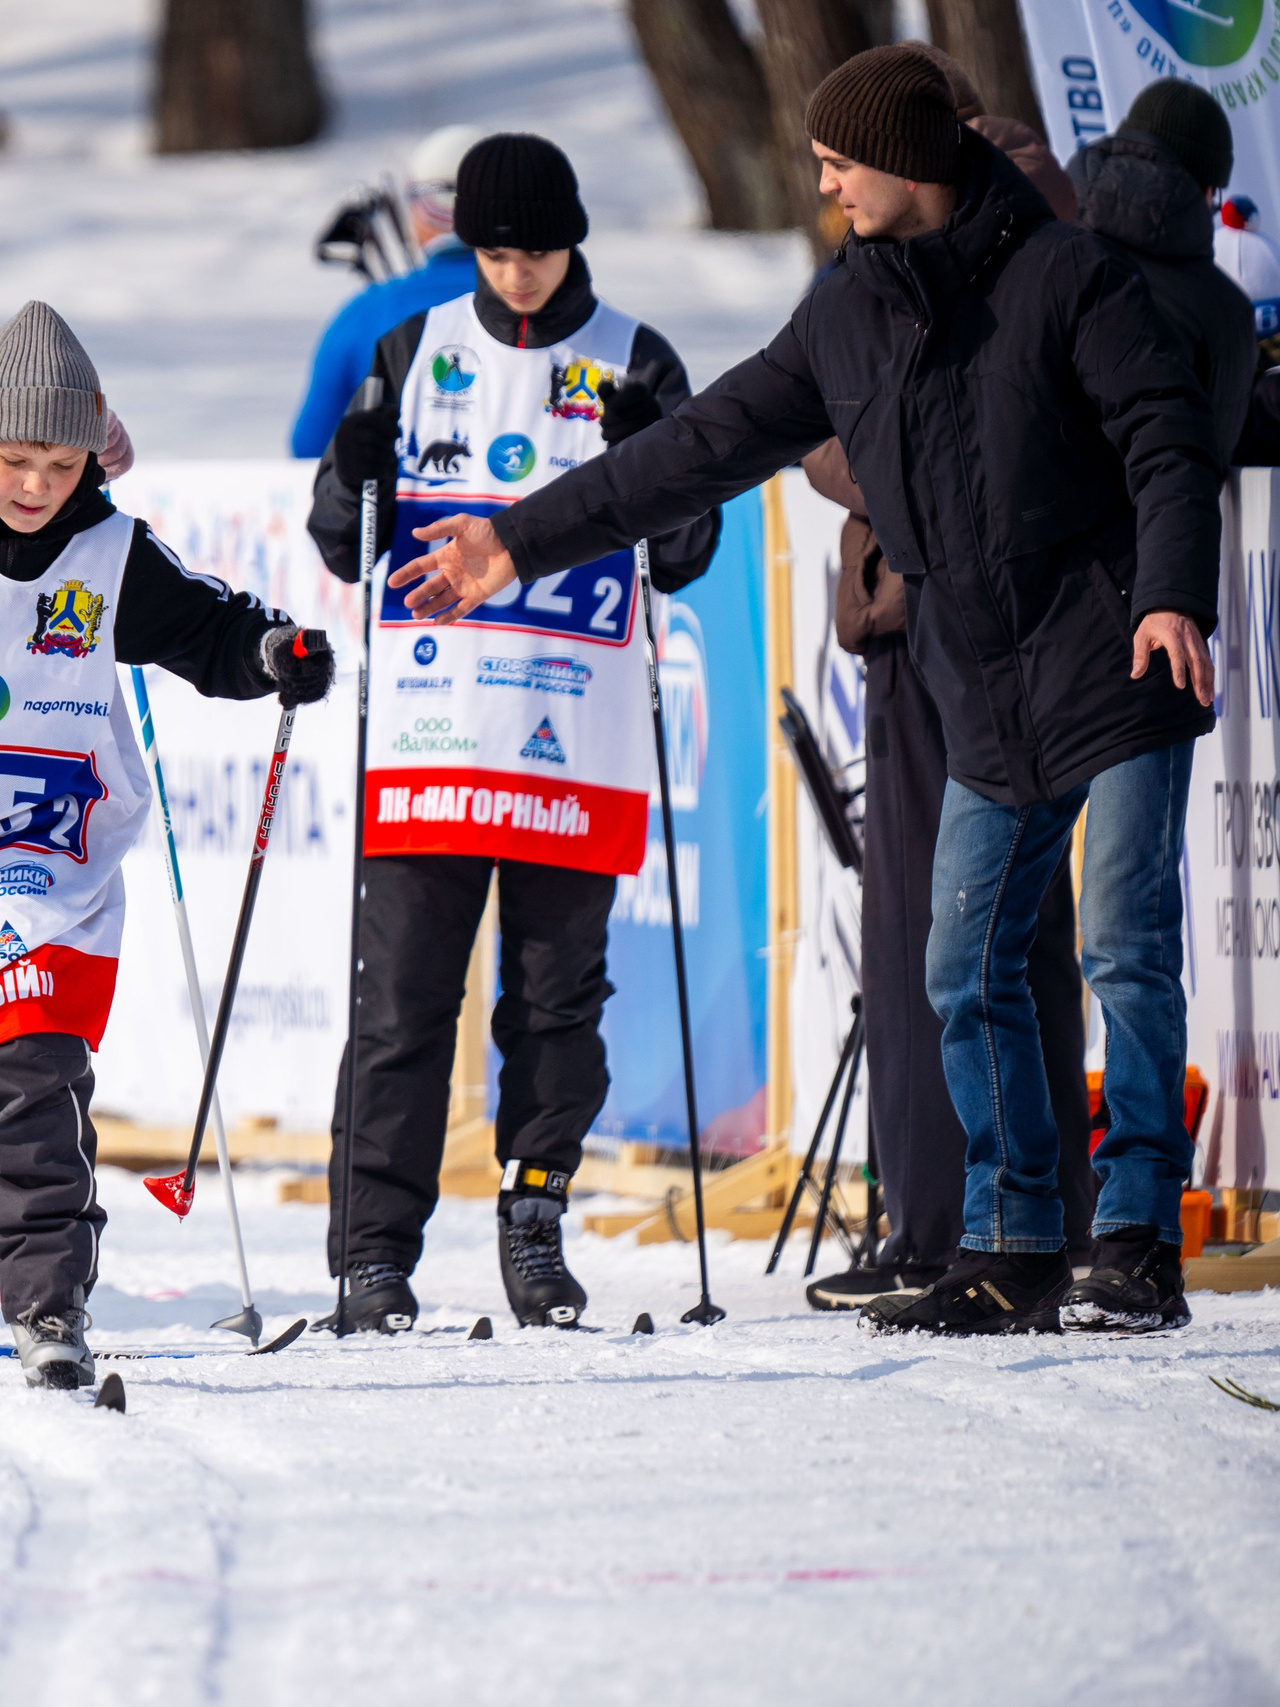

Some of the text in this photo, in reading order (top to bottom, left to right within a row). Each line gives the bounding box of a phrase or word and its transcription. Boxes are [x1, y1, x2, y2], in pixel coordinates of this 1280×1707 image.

[363, 503, 376, 575] NORDWAY
[589, 576, 622, 631] 2
[476, 674, 585, 697] ЕДИНОЙ РОССИИ
[478, 656, 587, 684] СТОРОННИКИ
[415, 717, 452, 732] ООО
[49, 793, 80, 847] 2
[377, 787, 410, 823] ЛК
[411, 786, 590, 836] «НАГОРНЫЙ»
